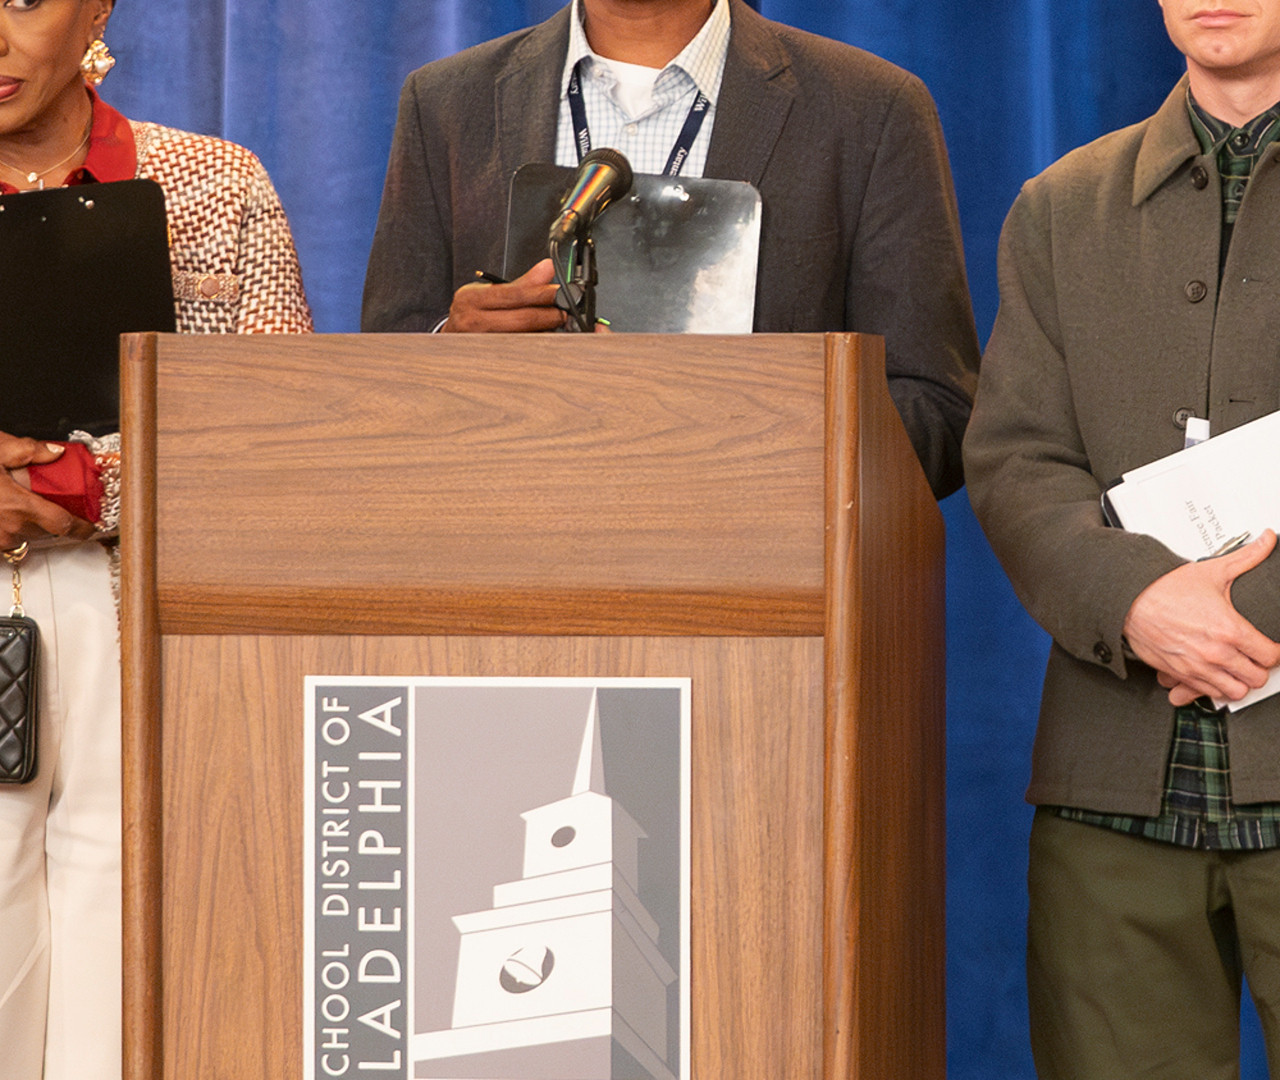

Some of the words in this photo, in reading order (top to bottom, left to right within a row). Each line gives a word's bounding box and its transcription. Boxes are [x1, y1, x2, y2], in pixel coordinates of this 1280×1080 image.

[669, 146, 689, 176] entary
[1185, 500, 1200, 522] Fair
[1204, 504, 1226, 541] Packet
[1197, 522, 1217, 555] cience
[321, 696, 350, 746] OF
[321, 760, 350, 916] DISTRICT
[356, 695, 402, 1071] LADELPHIA
[321, 944, 350, 1078] CHOOL
